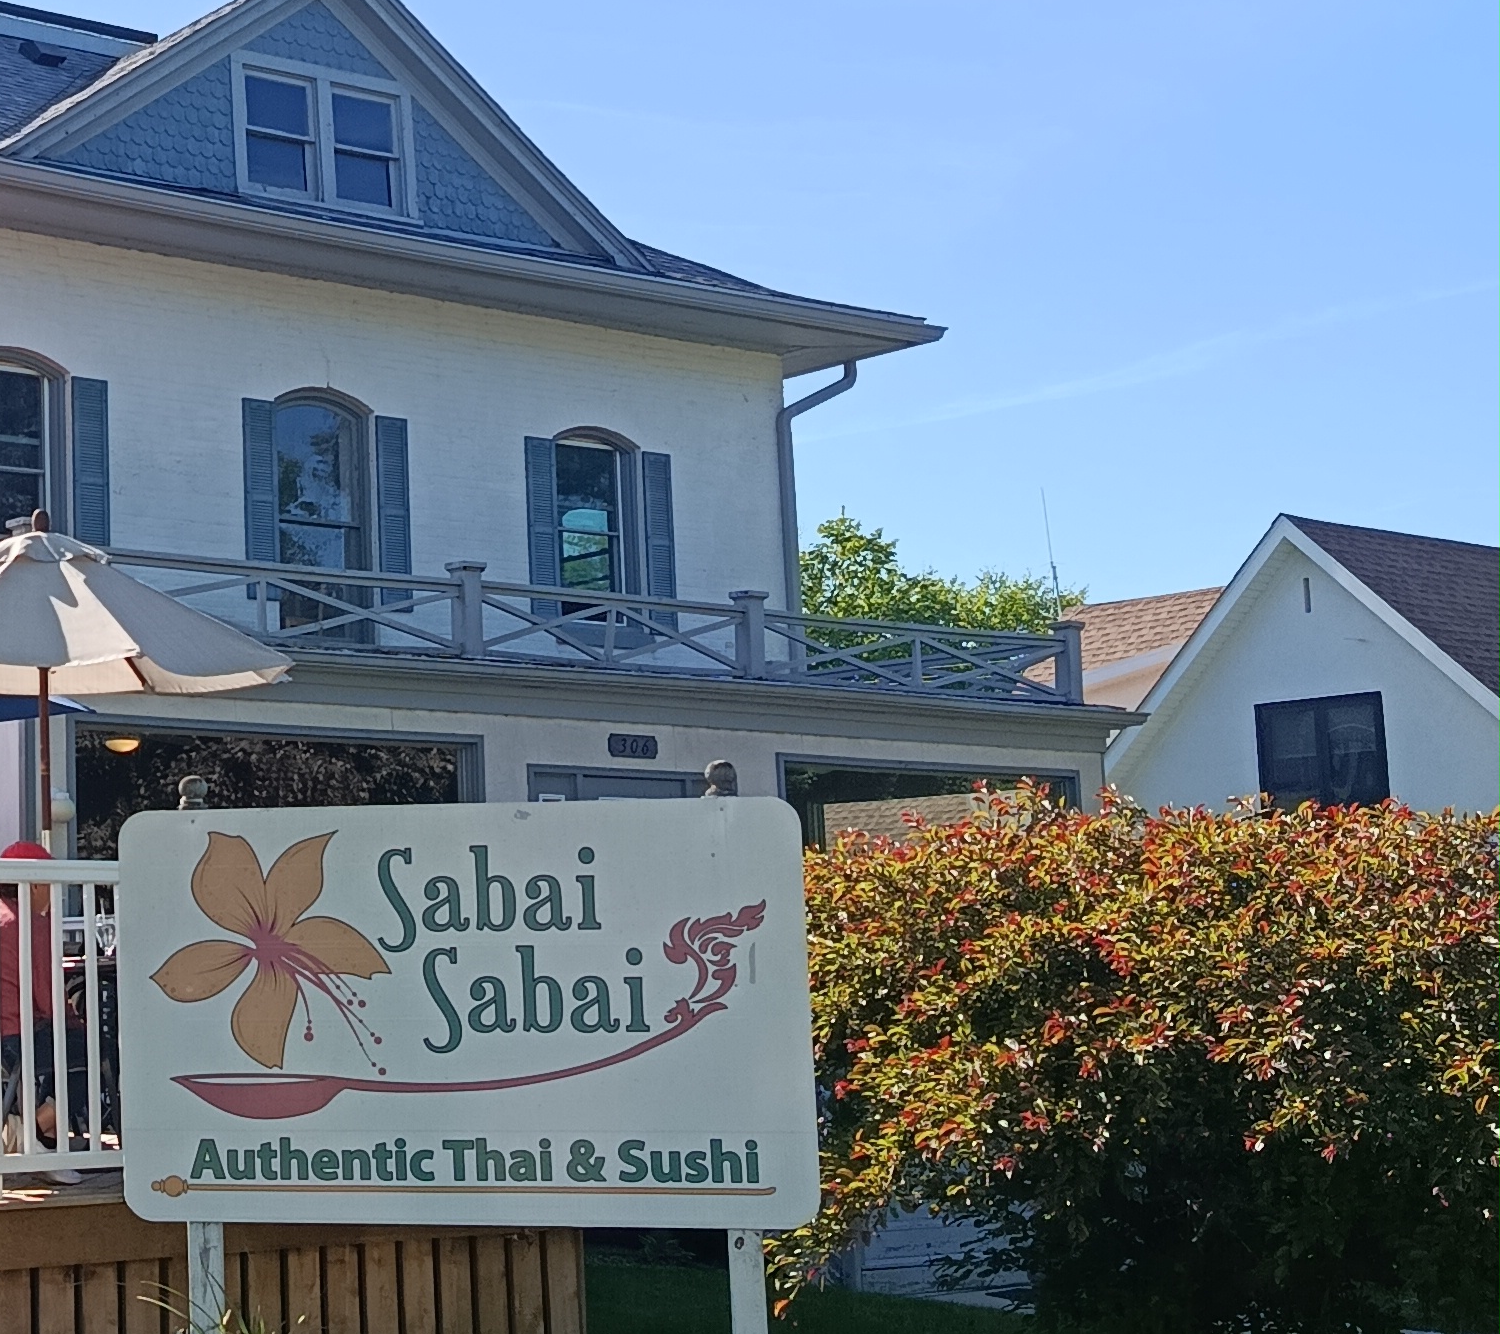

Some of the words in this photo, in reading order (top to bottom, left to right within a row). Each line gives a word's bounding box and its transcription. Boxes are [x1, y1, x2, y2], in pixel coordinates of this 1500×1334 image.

[618, 737, 650, 755] 306
[376, 844, 602, 953] Sabai
[422, 945, 651, 1054] Sabai
[190, 1136, 436, 1182] Authentic
[441, 1137, 553, 1183] Thai
[566, 1138, 608, 1183] &
[617, 1138, 760, 1184] Sushi
